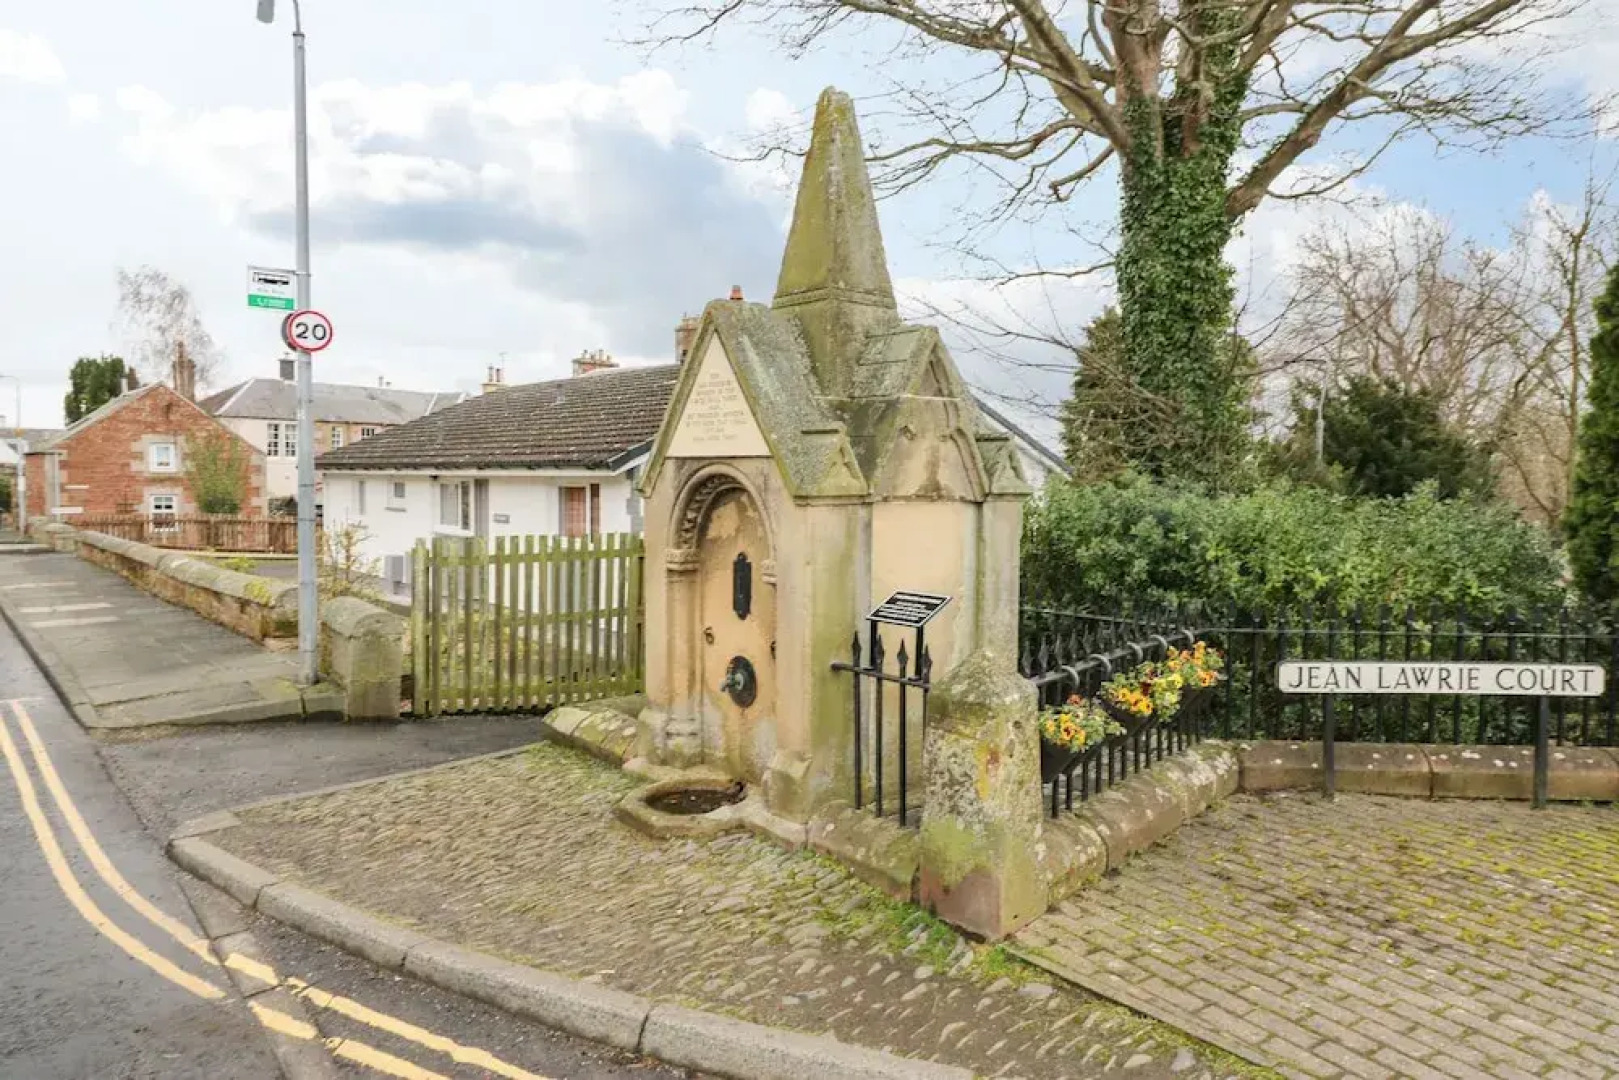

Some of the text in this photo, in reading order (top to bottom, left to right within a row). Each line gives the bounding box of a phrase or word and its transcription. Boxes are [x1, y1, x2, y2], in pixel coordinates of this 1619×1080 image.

[295, 322, 327, 341] 20
[1289, 666, 1595, 692] JEAN LAWRIE COURT
